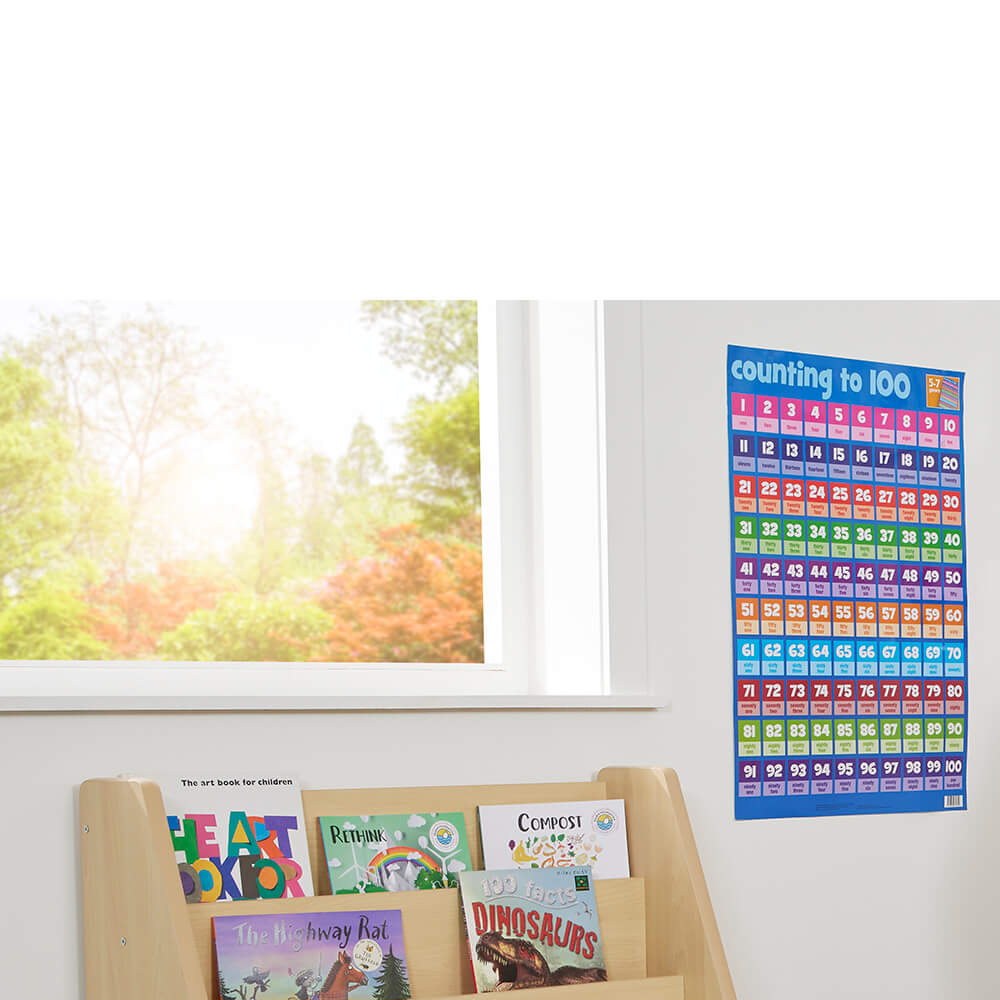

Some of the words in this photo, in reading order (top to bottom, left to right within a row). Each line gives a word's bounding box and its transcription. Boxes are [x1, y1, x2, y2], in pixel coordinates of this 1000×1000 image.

[731, 359, 832, 400] counting
[840, 367, 862, 393] to
[869, 369, 911, 399] 100
[740, 398, 746, 412] 1
[763, 400, 772, 414] 2
[787, 402, 796, 417] 3
[810, 405, 820, 419] 4
[834, 407, 843, 422] 5
[857, 410, 866, 424] 6
[880, 412, 889, 425] 7
[902, 414, 911, 428] 8
[924, 416, 933, 430] 9
[944, 418, 956, 433] 10
[739, 439, 748, 453] 11
[762, 441, 775, 455] 12
[786, 443, 799, 458] 13
[809, 445, 822, 459] 14
[833, 447, 845, 462] 15
[856, 449, 868, 463] 16
[879, 451, 890, 465] 17
[901, 453, 913, 467] 18
[923, 455, 935, 468] 19
[942, 456, 959, 471] 20
[739, 520, 752, 535] 31
[762, 521, 779, 536] 32
[786, 523, 802, 538] 33
[809, 524, 827, 539] 34
[833, 526, 850, 540] 35
[856, 527, 873, 541] 36
[879, 528, 895, 543] 37
[901, 530, 917, 544] 38
[923, 531, 939, 545] 39
[944, 533, 961, 547] 40
[741, 602, 754, 617] 51
[763, 603, 781, 617] 52
[788, 604, 805, 618] 53
[811, 604, 829, 618] 54
[835, 605, 852, 619] 55
[858, 606, 875, 620] 56
[881, 606, 896, 620] 57
[903, 607, 919, 621] 58
[925, 608, 940, 622] 59
[946, 609, 962, 622] 60
[743, 684, 755, 697] 71
[765, 683, 782, 697] 72
[789, 683, 805, 698] 73
[814, 684, 829, 697] 74
[836, 684, 852, 698] 75
[859, 684, 875, 698] 76
[882, 684, 898, 697] 77
[904, 684, 920, 698] 78
[926, 684, 941, 697] 79
[947, 684, 963, 698] 80
[181, 779, 198, 787] The
[201, 779, 215, 787] art
[217, 779, 240, 787] book
[243, 778, 256, 786] for
[258, 778, 293, 786] children
[743, 765, 757, 778] 91
[766, 763, 783, 778] 92
[790, 763, 807, 777] 93
[814, 763, 831, 776] 94
[837, 762, 854, 776] 95
[860, 761, 877, 775] 96
[883, 761, 899, 775] 97
[905, 761, 921, 774] 98
[926, 760, 941, 773] 99
[945, 759, 962, 773] 100
[227, 811, 298, 859] ART
[330, 825, 387, 844] RETHINK
[518, 813, 582, 832] COMPOST
[481, 876, 517, 897] 100
[526, 880, 577, 905] facts
[232, 921, 268, 945] The
[273, 919, 351, 952] Highway
[358, 915, 389, 940] Rat
[472, 902, 598, 959] DINOSAURS
